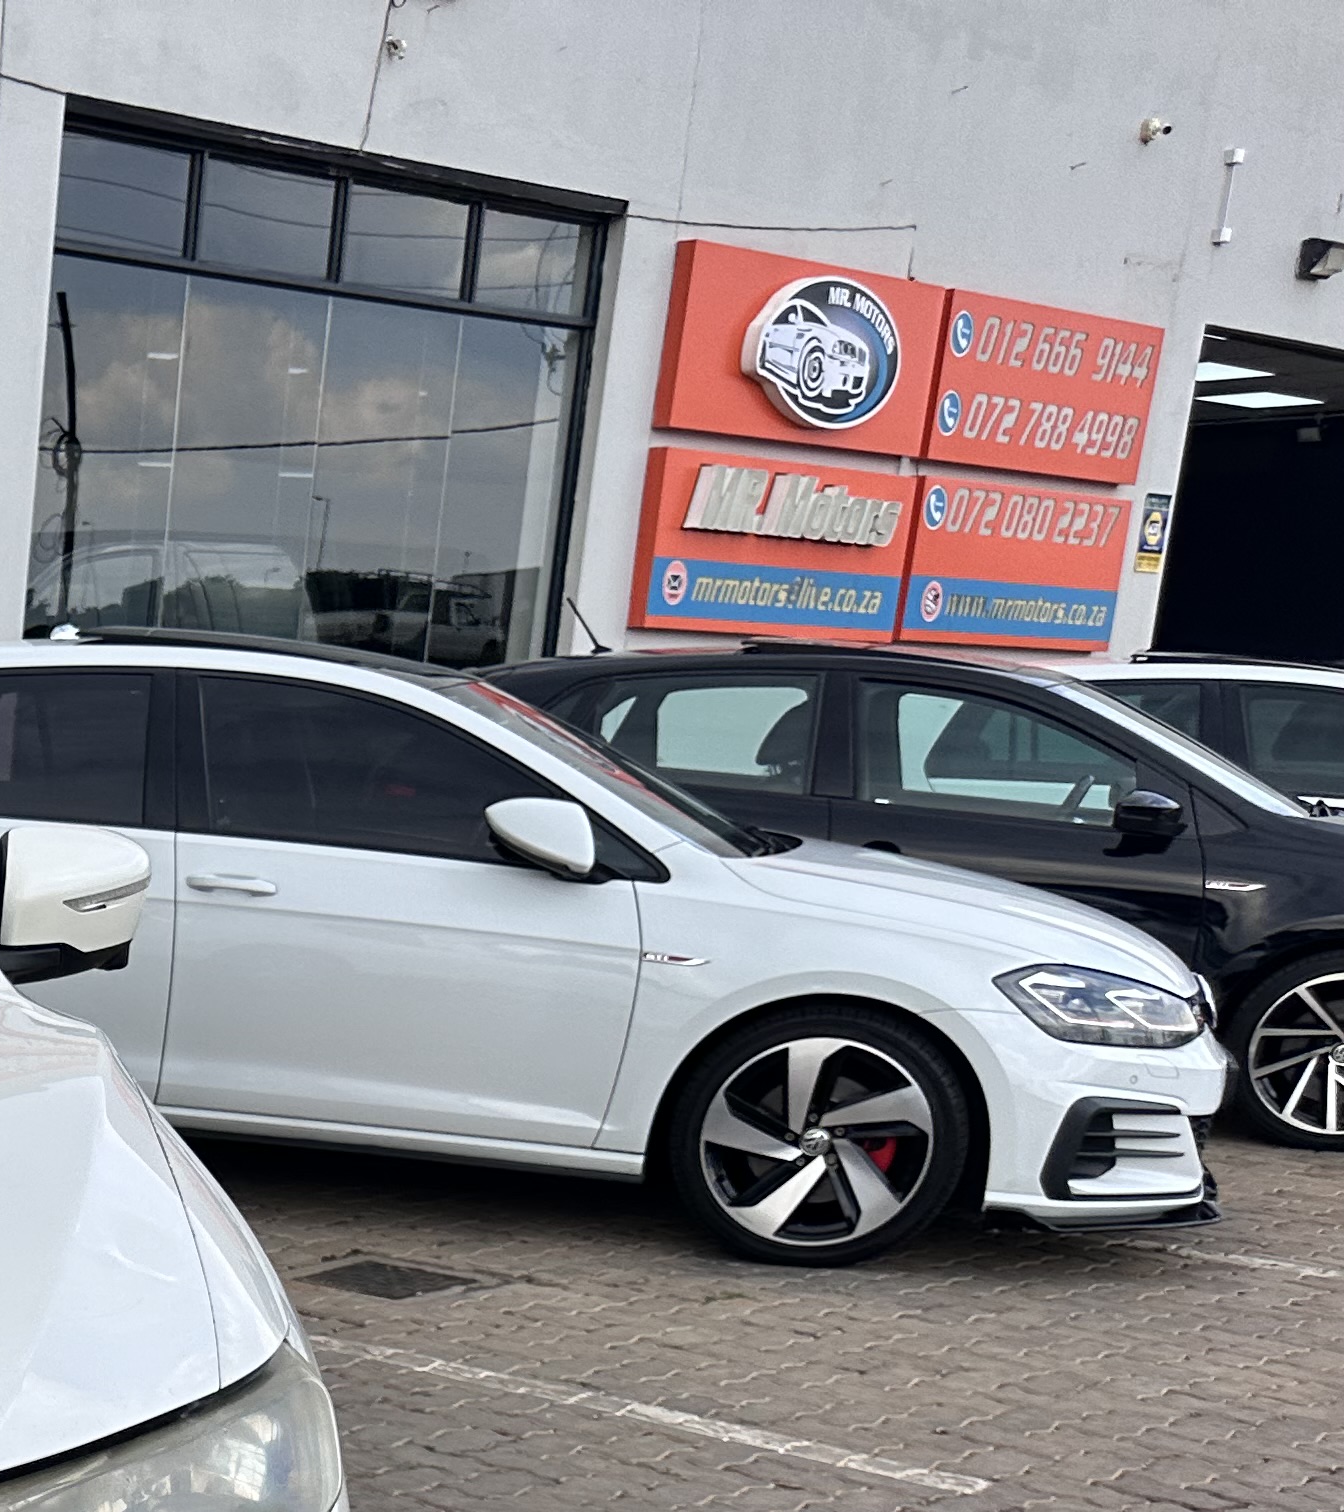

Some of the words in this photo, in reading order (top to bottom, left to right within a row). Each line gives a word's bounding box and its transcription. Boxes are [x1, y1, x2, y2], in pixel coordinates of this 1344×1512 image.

[828, 287, 851, 307] MR.
[852, 293, 895, 355] MOTORS
[976, 316, 1035, 367] 012
[1032, 326, 1088, 376] 666
[1091, 337, 1156, 388] 9144
[963, 393, 1021, 444] 072
[1019, 402, 1075, 450] 788
[1072, 410, 1140, 459] 4998
[759, 473, 903, 548] Motors
[946, 487, 1005, 536] 072
[1000, 495, 1057, 541] 080
[1053, 501, 1122, 547] 2237
